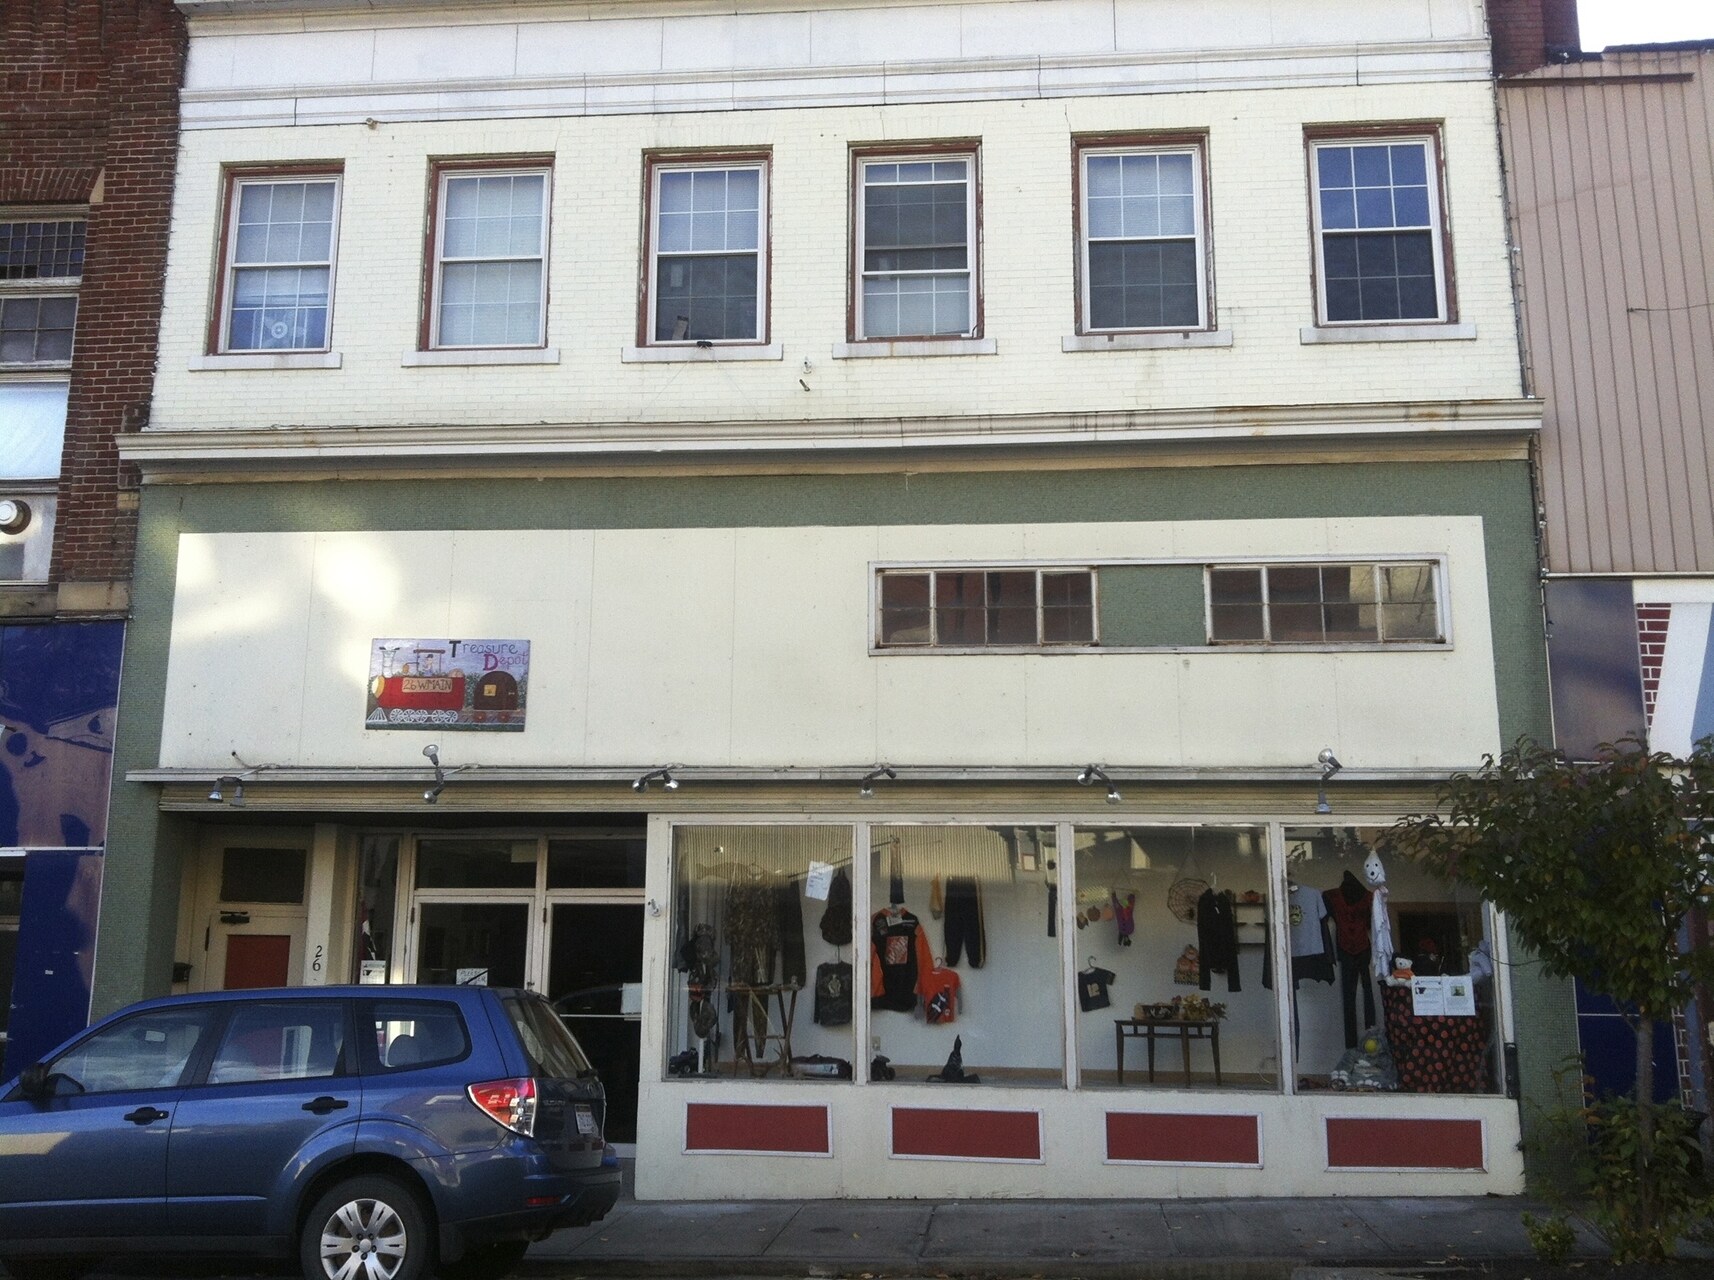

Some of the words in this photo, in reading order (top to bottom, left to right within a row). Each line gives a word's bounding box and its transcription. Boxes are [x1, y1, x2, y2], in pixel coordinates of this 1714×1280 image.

[449, 640, 519, 658] Treasure
[483, 652, 529, 671] Depot
[403, 679, 417, 690] 26
[427, 679, 452, 690] MAIN
[312, 945, 323, 972] 26
